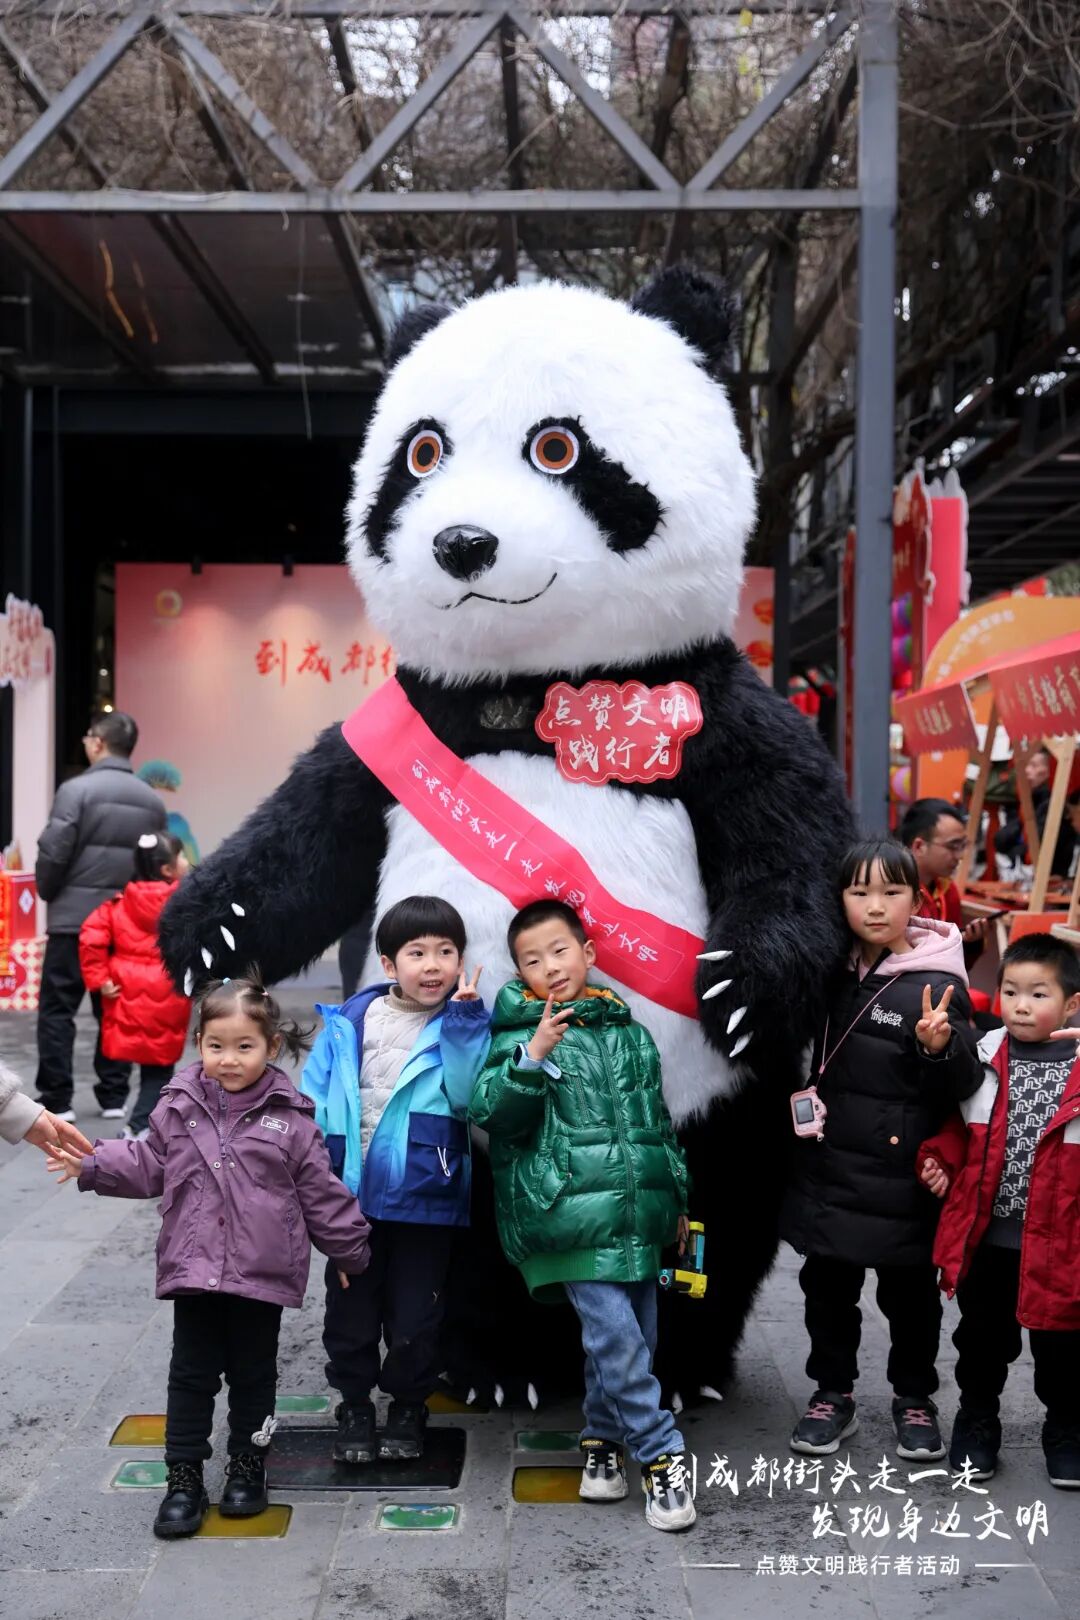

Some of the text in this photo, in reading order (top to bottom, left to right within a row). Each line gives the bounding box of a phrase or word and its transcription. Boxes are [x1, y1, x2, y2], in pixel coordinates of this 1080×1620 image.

[548, 693, 691, 731] 点赞文明
[568, 732, 672, 774] 践行者
